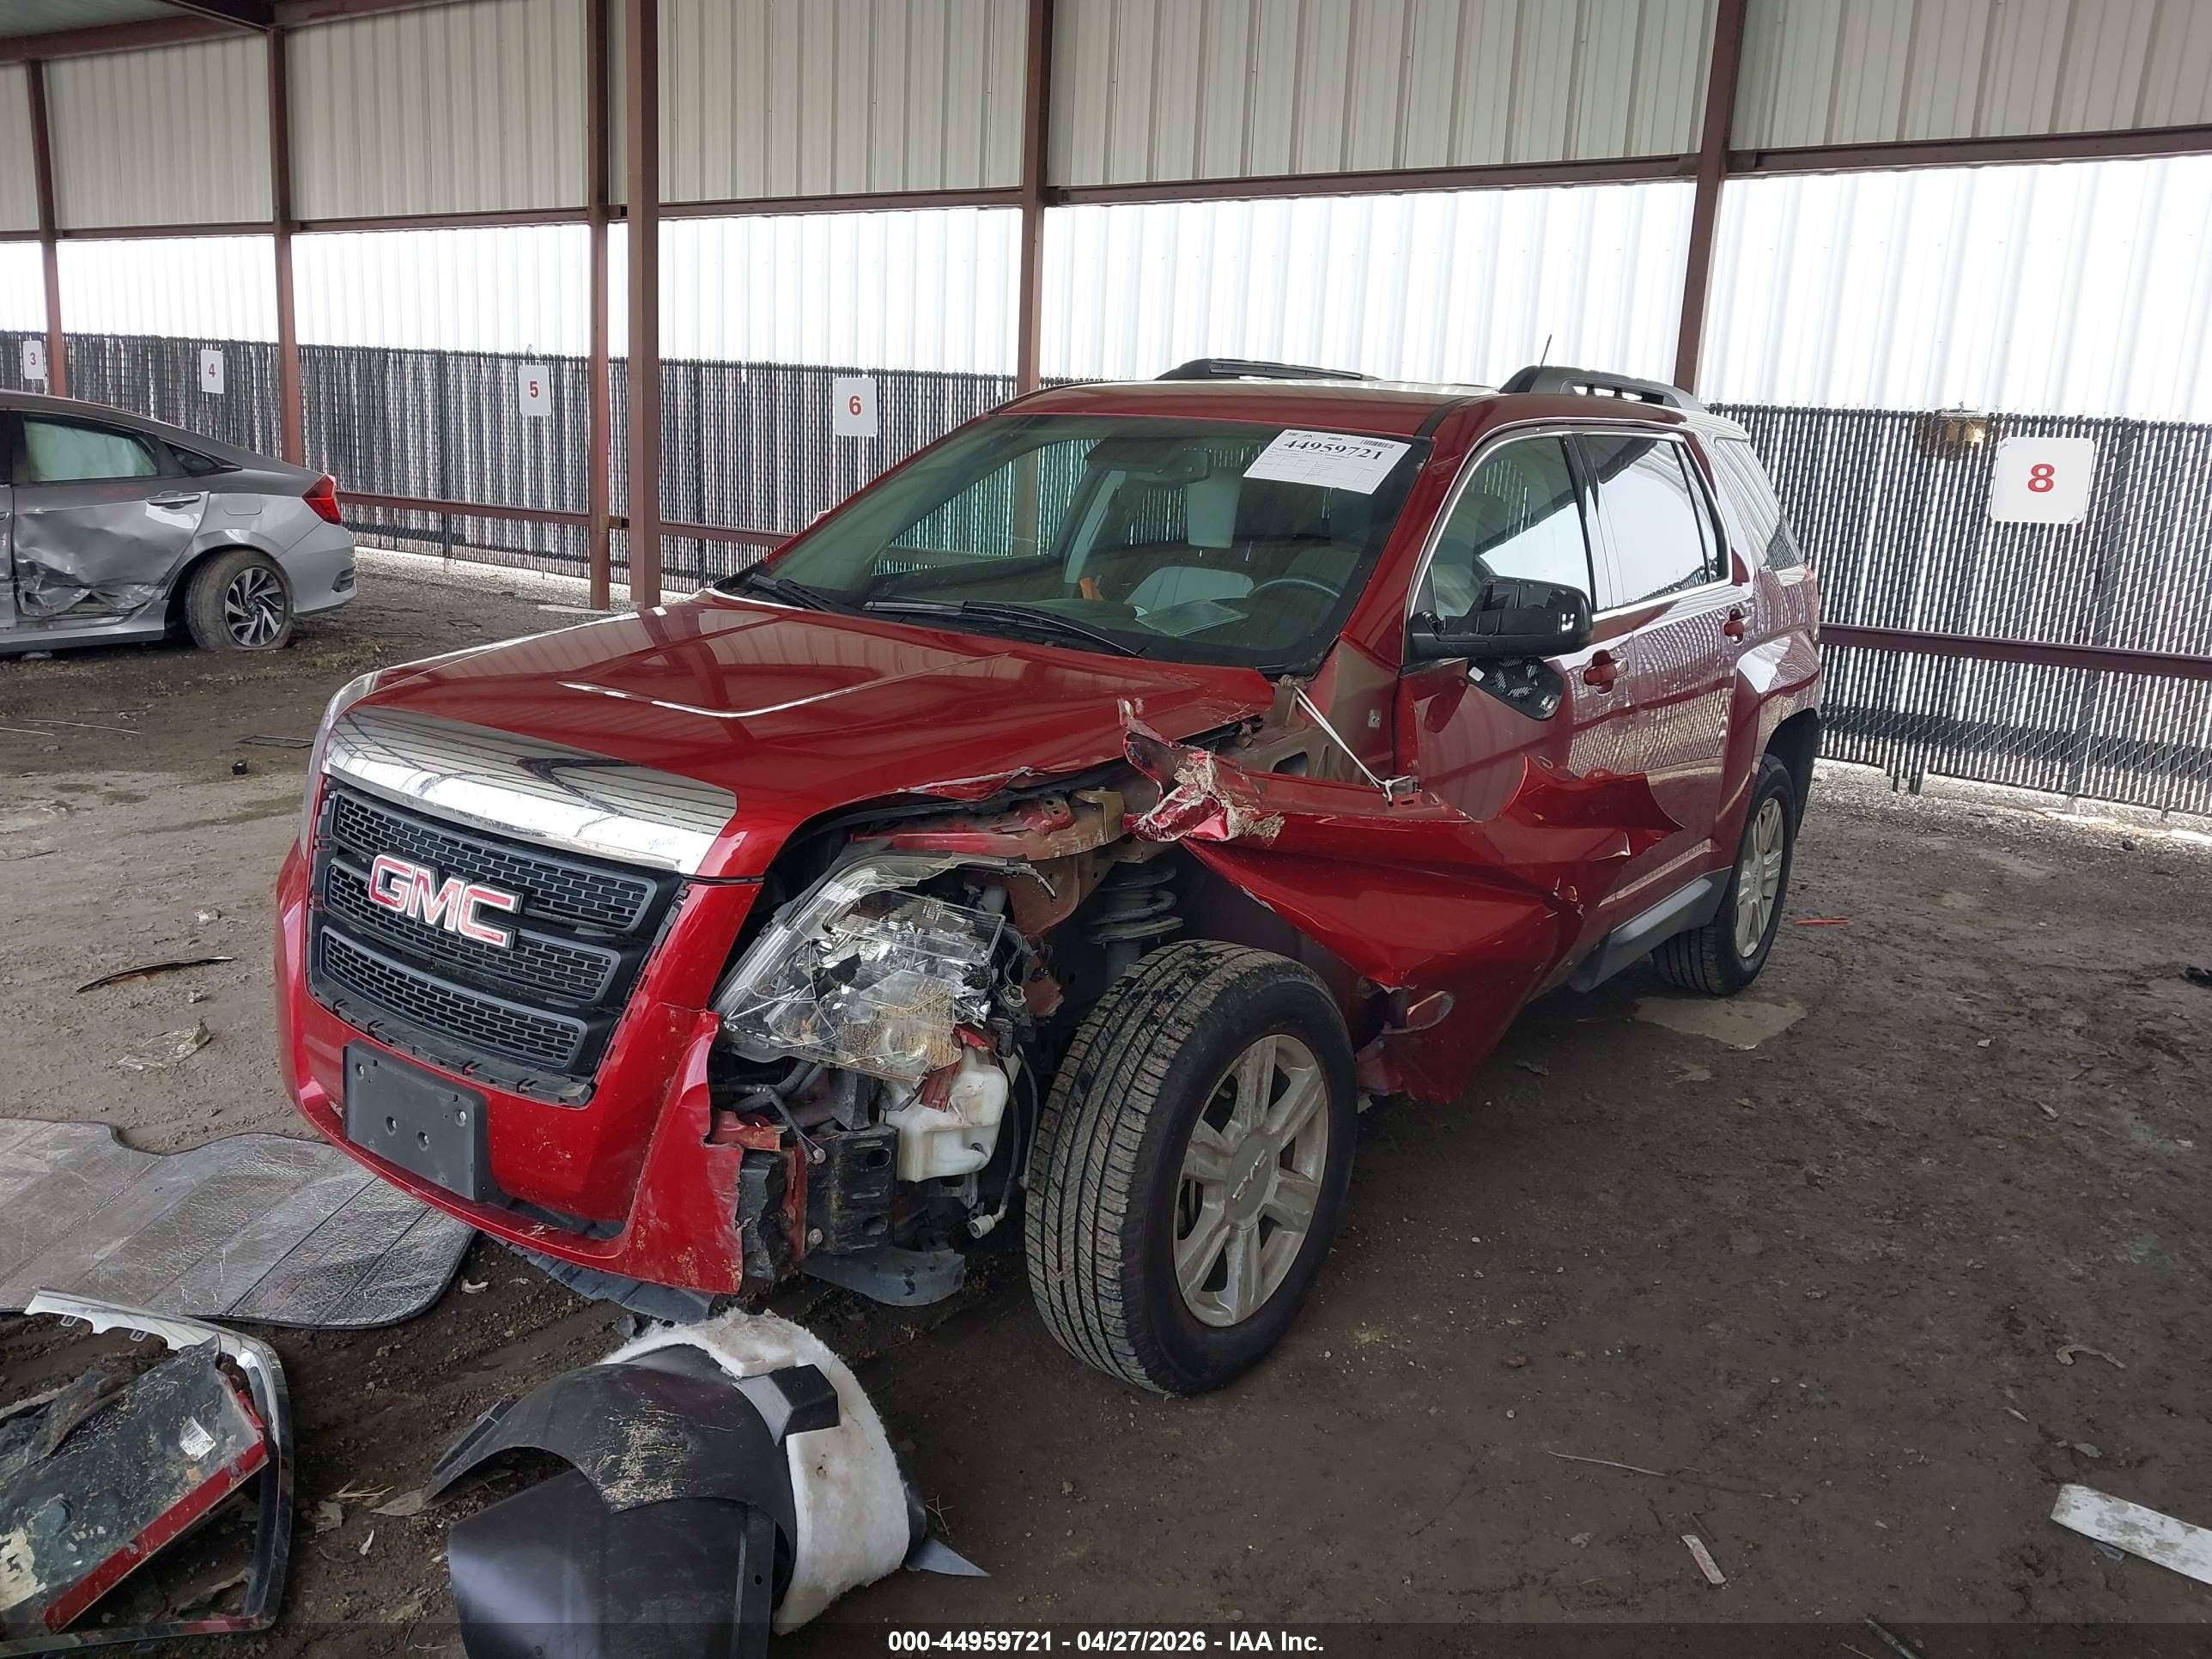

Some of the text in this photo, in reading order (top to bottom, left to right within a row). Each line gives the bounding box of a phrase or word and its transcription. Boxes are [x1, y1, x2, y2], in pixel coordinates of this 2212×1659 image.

[29, 352, 36, 366] 3
[209, 363, 216, 378] 4
[529, 380, 539, 398] 5
[849, 395, 861, 416] 6
[1284, 439, 1383, 460] 44959721
[2027, 464, 2055, 493] 8
[369, 854, 520, 947] GMC
